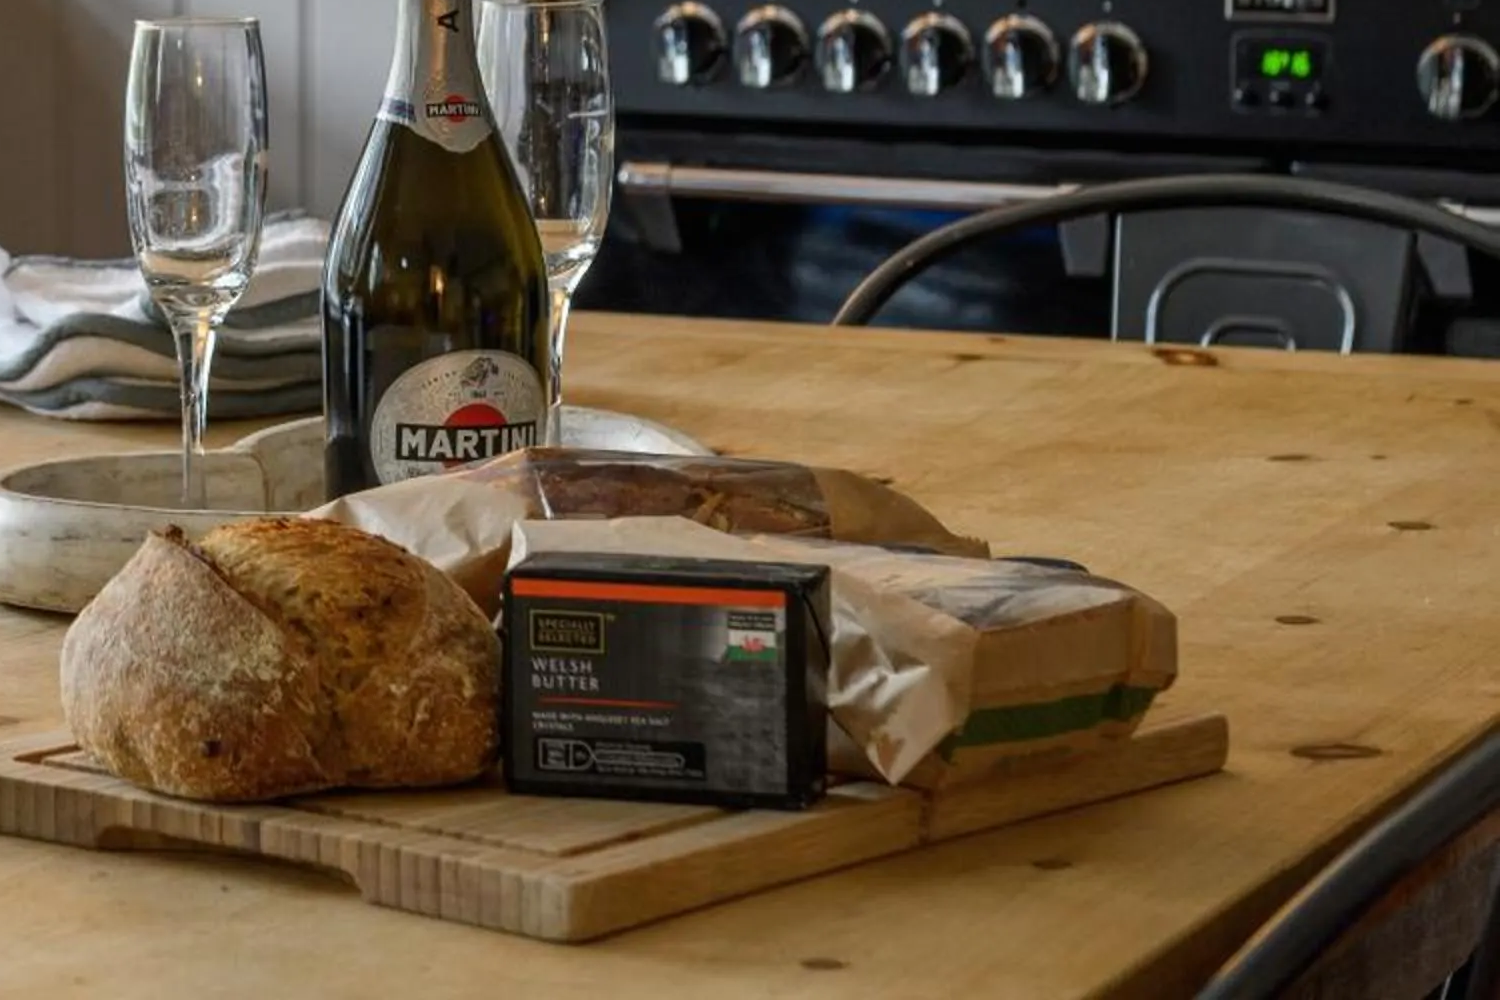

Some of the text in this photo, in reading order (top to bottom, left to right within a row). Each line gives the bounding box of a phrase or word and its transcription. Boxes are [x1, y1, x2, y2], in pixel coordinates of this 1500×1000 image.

[428, 103, 482, 116] MARTINI
[401, 425, 534, 458] MARTINI
[531, 656, 593, 673] WELSH
[531, 673, 600, 691] BUTTER
